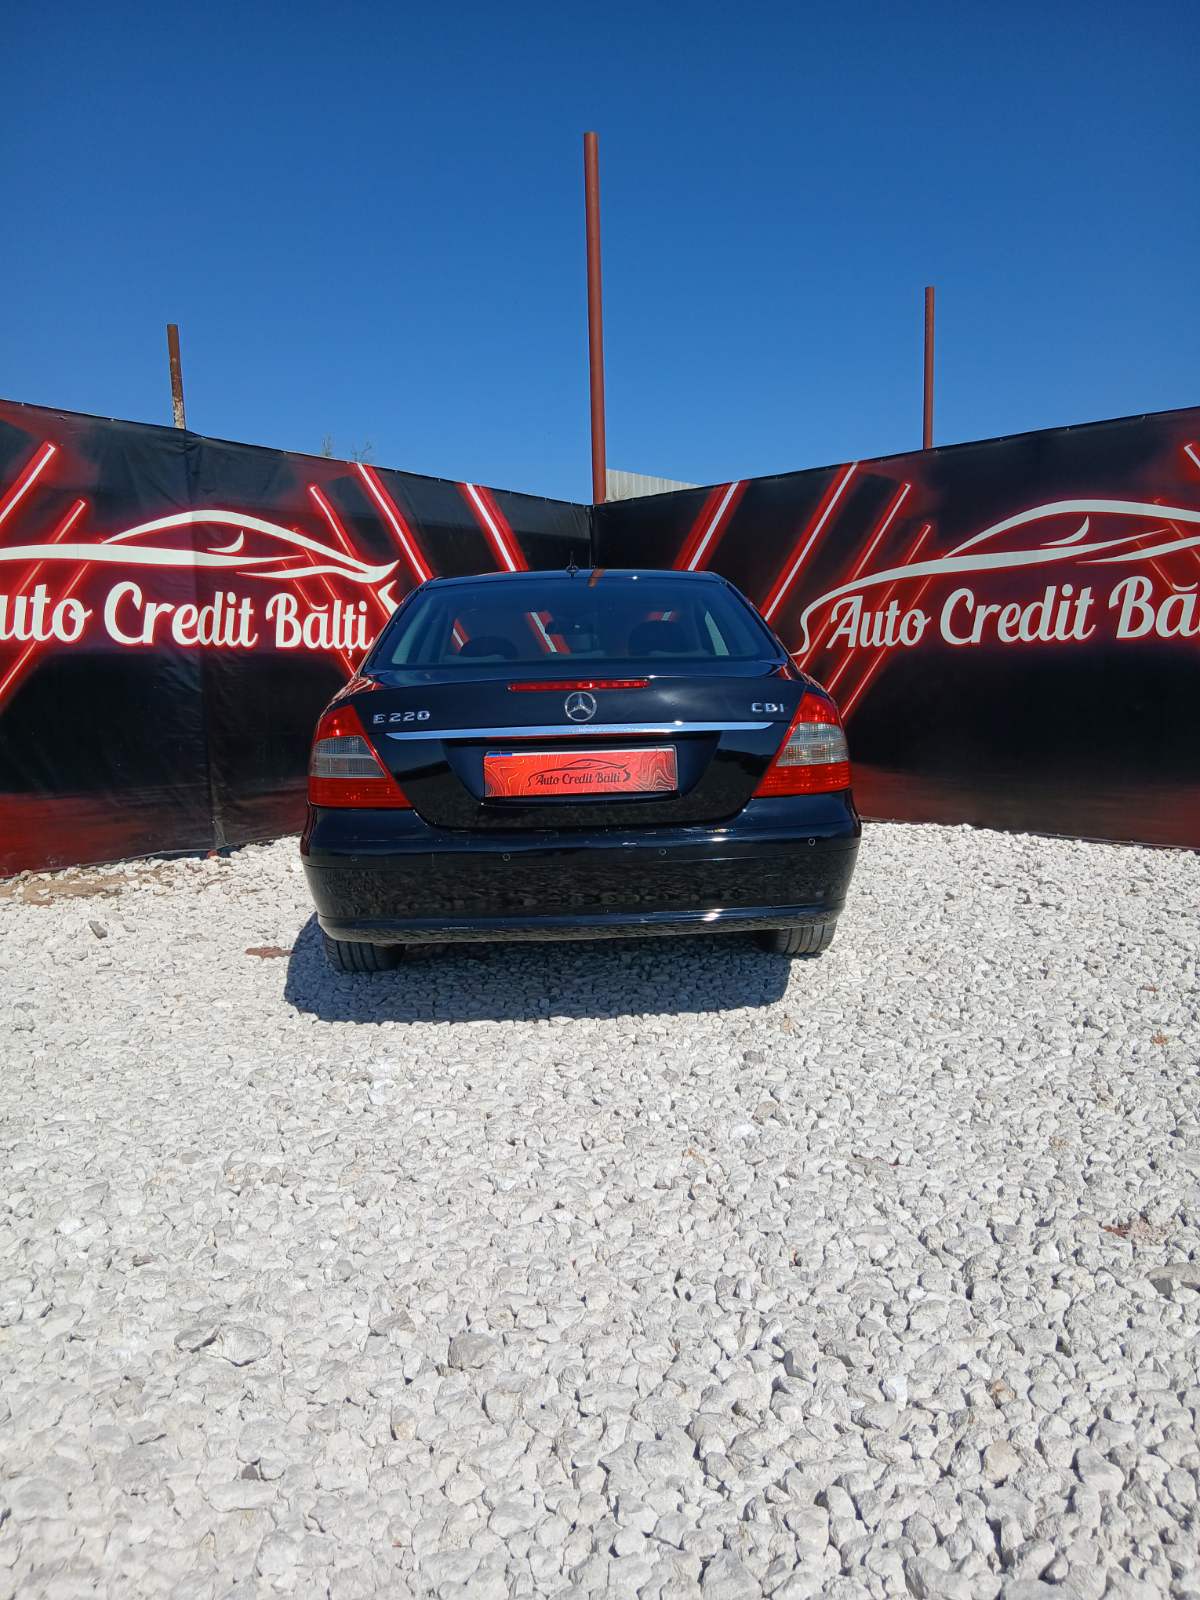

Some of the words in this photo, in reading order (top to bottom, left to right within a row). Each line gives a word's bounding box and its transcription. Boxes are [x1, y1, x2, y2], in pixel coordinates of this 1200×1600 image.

[0, 583, 92, 642] uto
[104, 581, 258, 648] Credit
[825, 595, 932, 649] Auto
[939, 583, 1096, 645] Credit
[1108, 575, 1200, 639] Bă
[373, 713, 386, 724] E
[388, 710, 431, 722] 220
[535, 774, 560, 785] Auto
[562, 772, 593, 785] Credit
